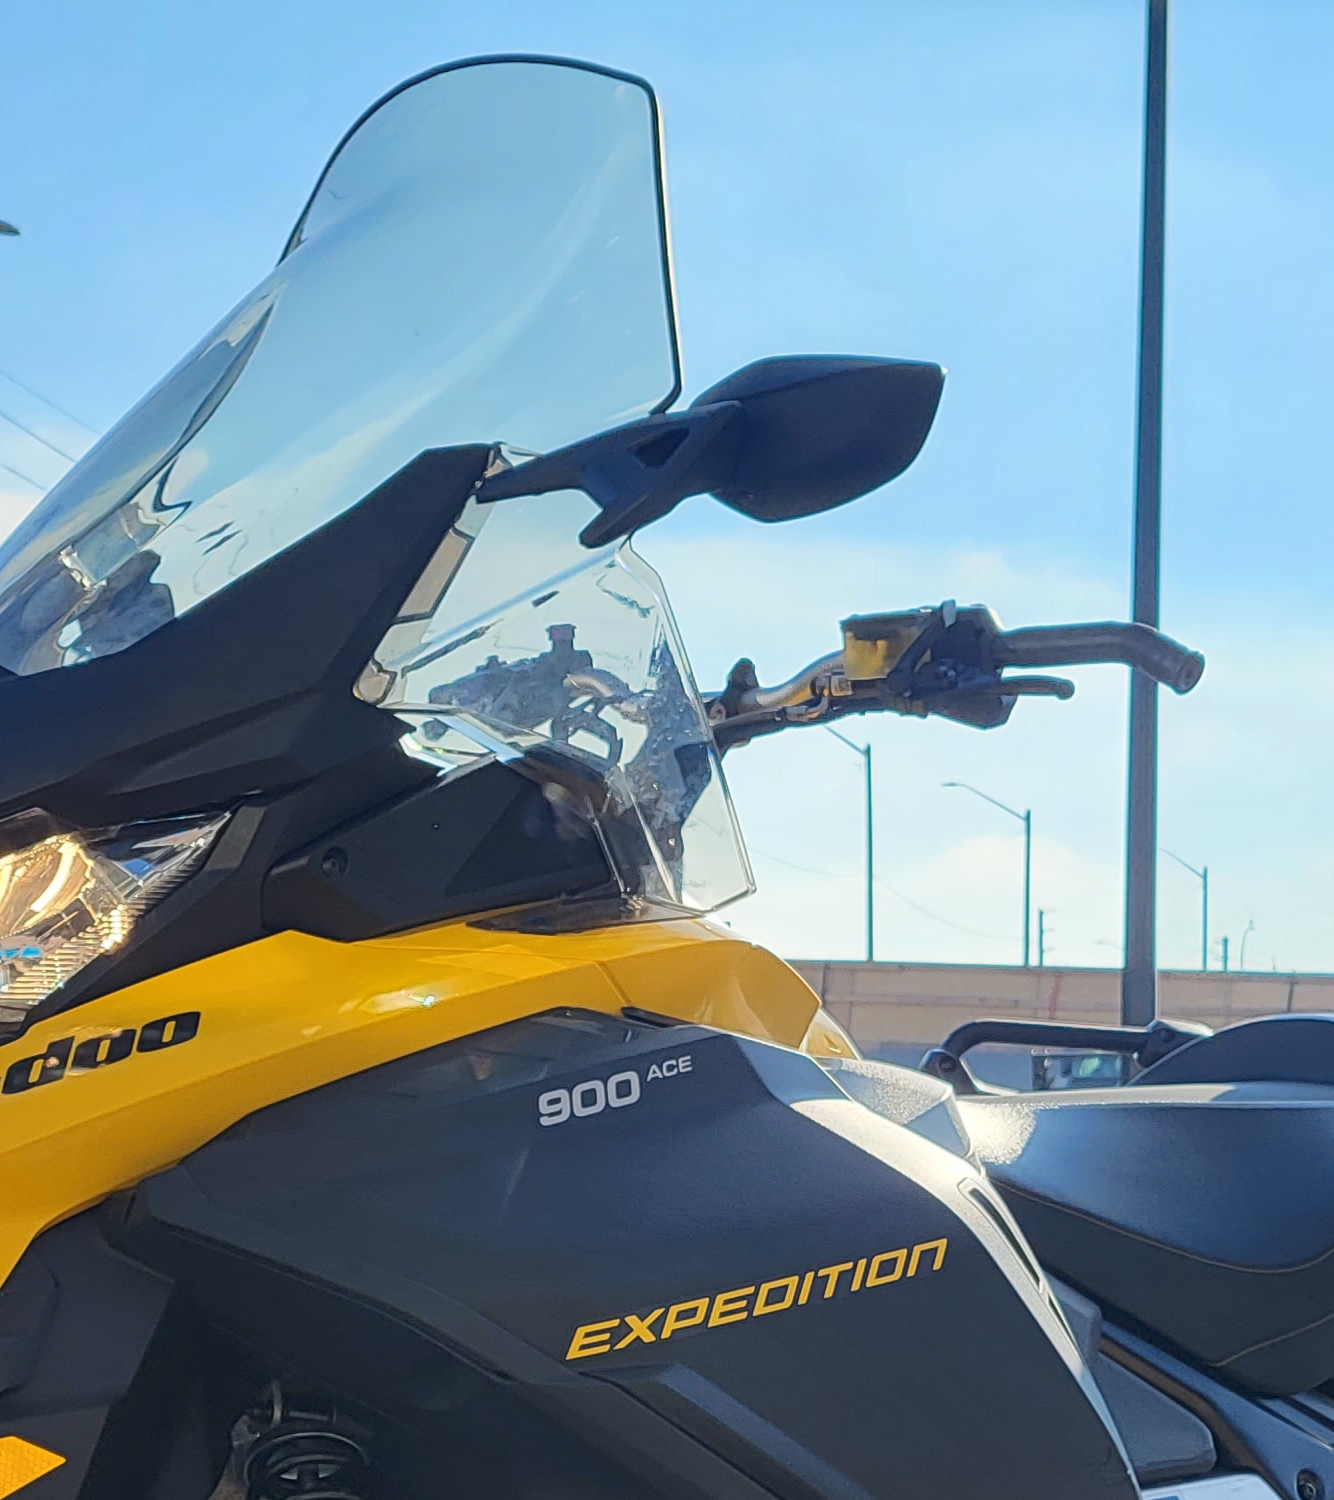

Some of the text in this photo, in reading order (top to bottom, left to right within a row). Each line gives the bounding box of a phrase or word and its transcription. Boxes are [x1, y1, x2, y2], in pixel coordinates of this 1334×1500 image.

[538, 1055, 693, 1127] 900 ACE
[565, 1237, 949, 1361] EXPEDITION
